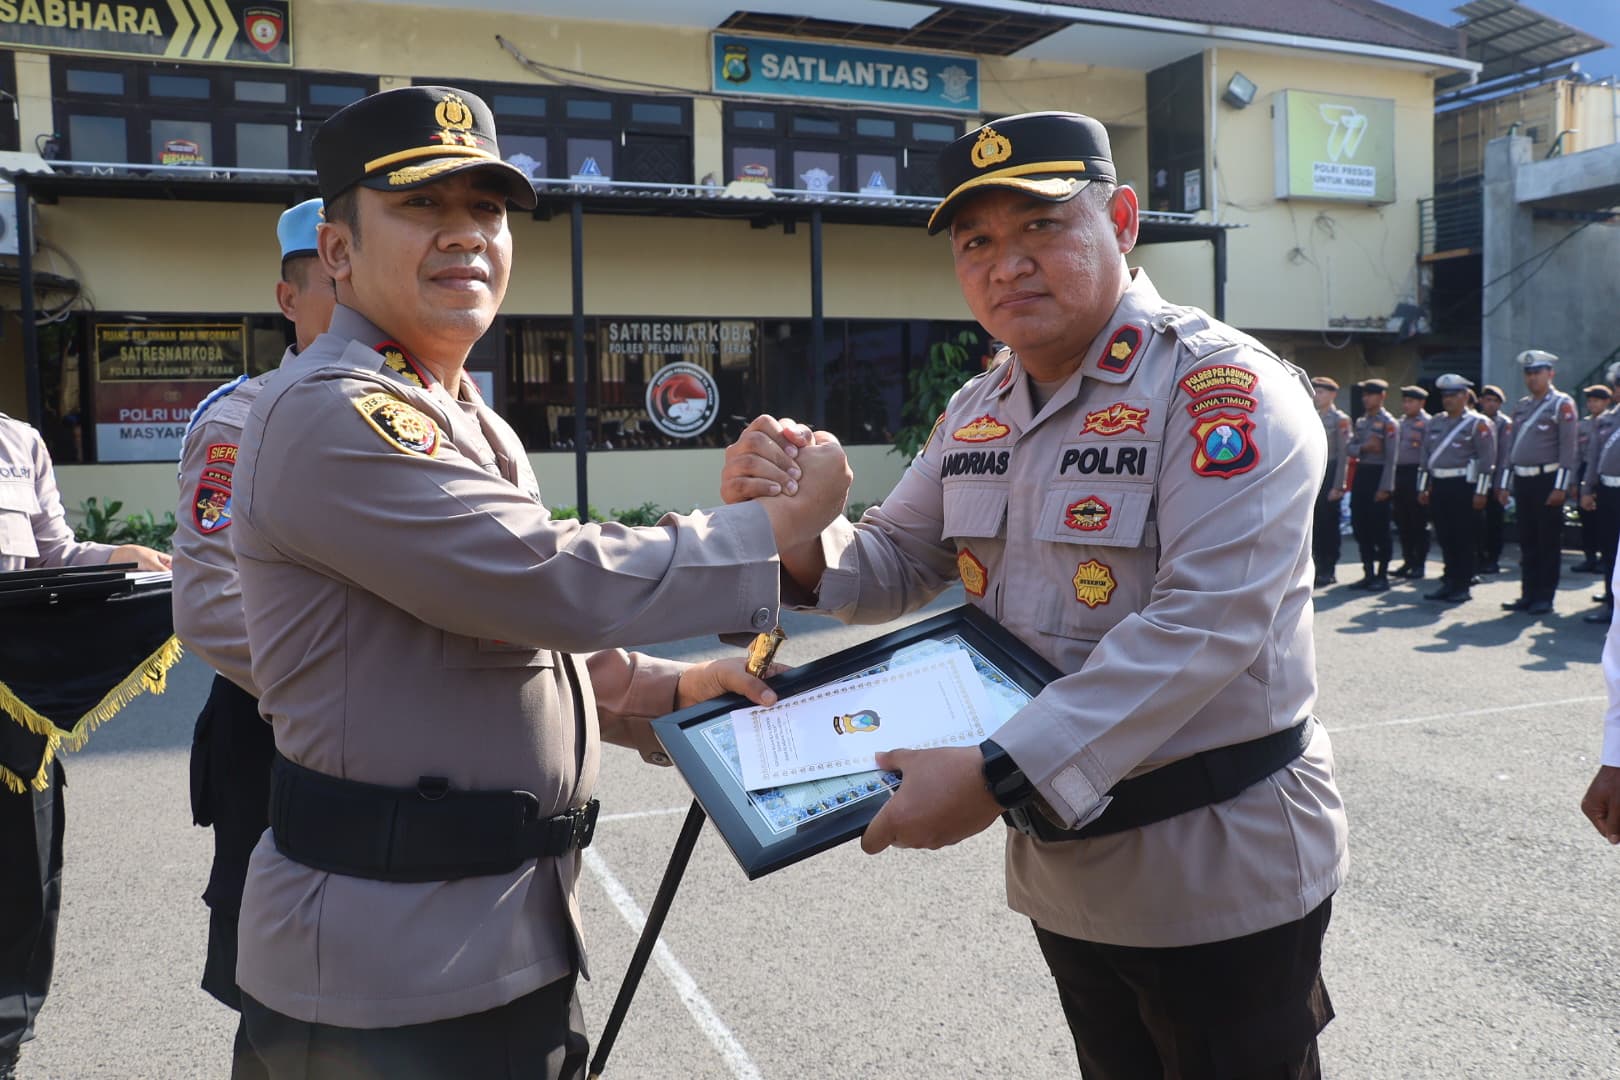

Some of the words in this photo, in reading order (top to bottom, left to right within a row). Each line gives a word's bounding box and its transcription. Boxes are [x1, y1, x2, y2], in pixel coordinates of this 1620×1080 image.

[0, 0, 163, 37] SABHARA
[761, 53, 929, 91] SATLANTAS
[609, 322, 752, 342] SATRESNARKOBA
[120, 346, 223, 361] SATRESNARKOBA
[609, 343, 643, 354] POLRES
[648, 343, 700, 354] PELABUHAN
[1185, 369, 1212, 386] POLRES
[1213, 368, 1254, 384] PELABUHAN
[1225, 377, 1250, 390] PERAK
[1194, 399, 1219, 411] JAWA
[1221, 397, 1251, 408] TIMUR
[119, 408, 167, 422] POLRI
[1060, 446, 1147, 476] POLRI
